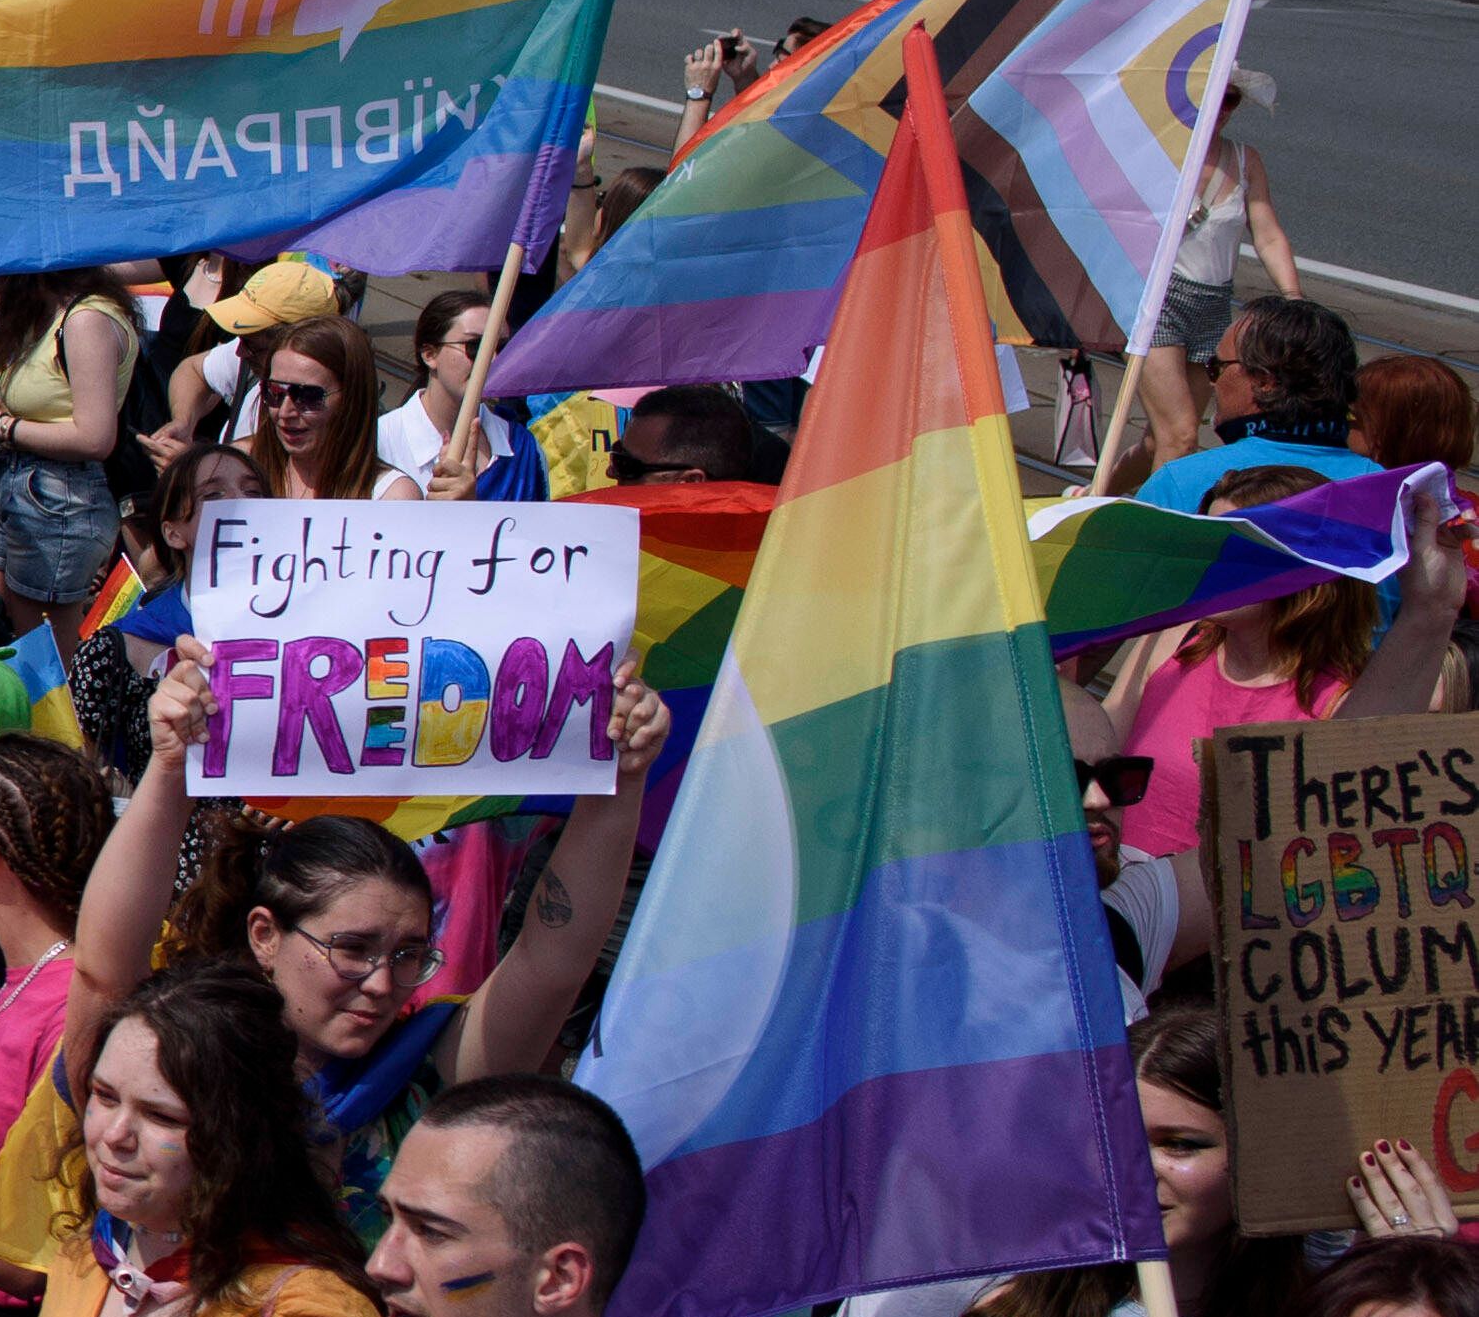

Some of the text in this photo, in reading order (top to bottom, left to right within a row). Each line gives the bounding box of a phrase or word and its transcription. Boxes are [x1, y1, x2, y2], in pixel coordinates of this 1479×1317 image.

[209, 516, 589, 627] Fighting for
[203, 635, 616, 780] FREEDOM
